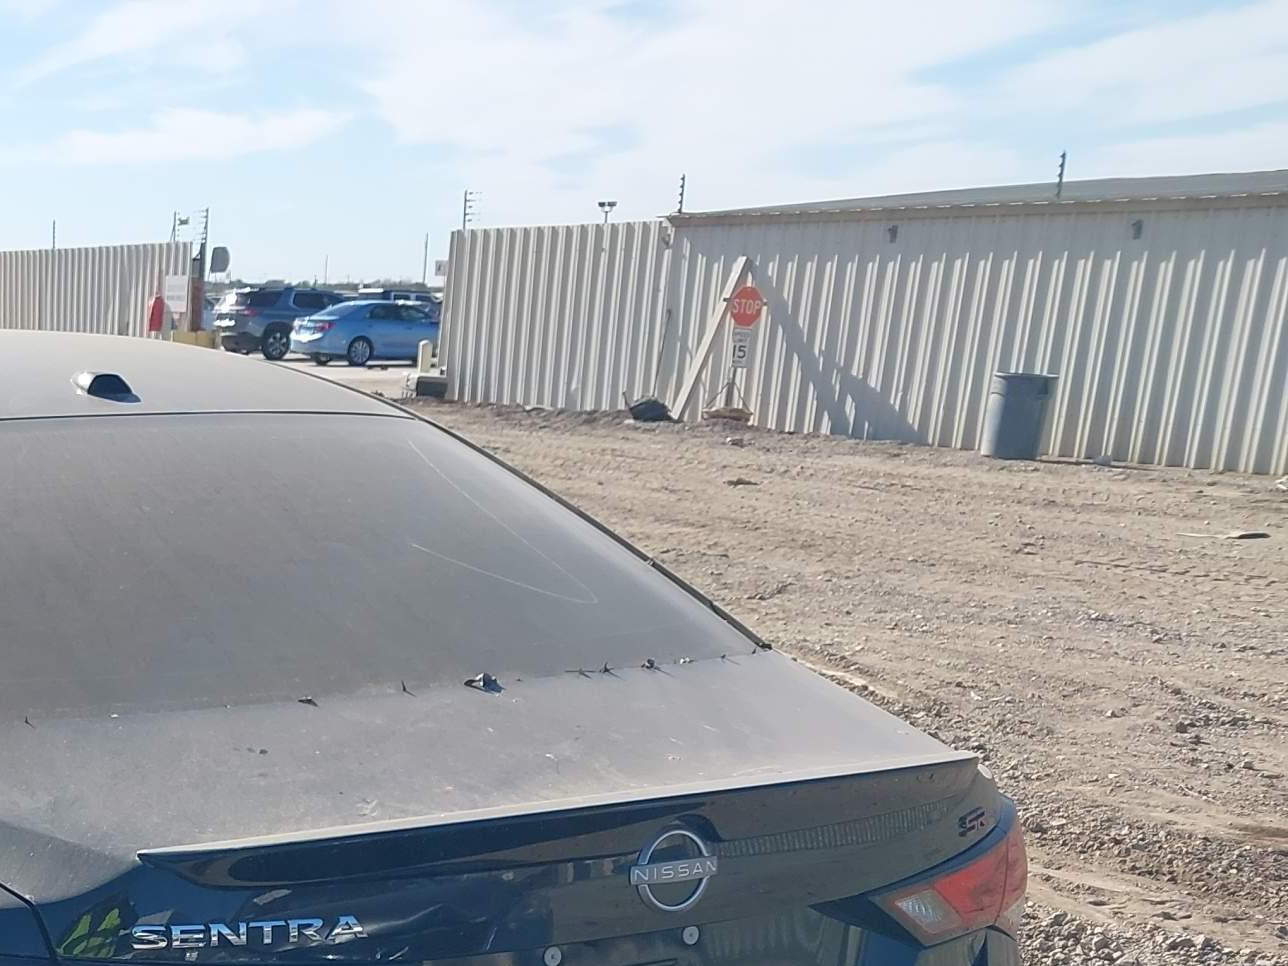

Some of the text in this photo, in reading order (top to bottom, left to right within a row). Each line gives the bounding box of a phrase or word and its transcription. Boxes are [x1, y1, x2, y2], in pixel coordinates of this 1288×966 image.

[732, 299, 761, 315] STOP
[732, 344, 747, 359] 15
[633, 860, 717, 881] NISSAN
[130, 914, 369, 950] SENTRA
